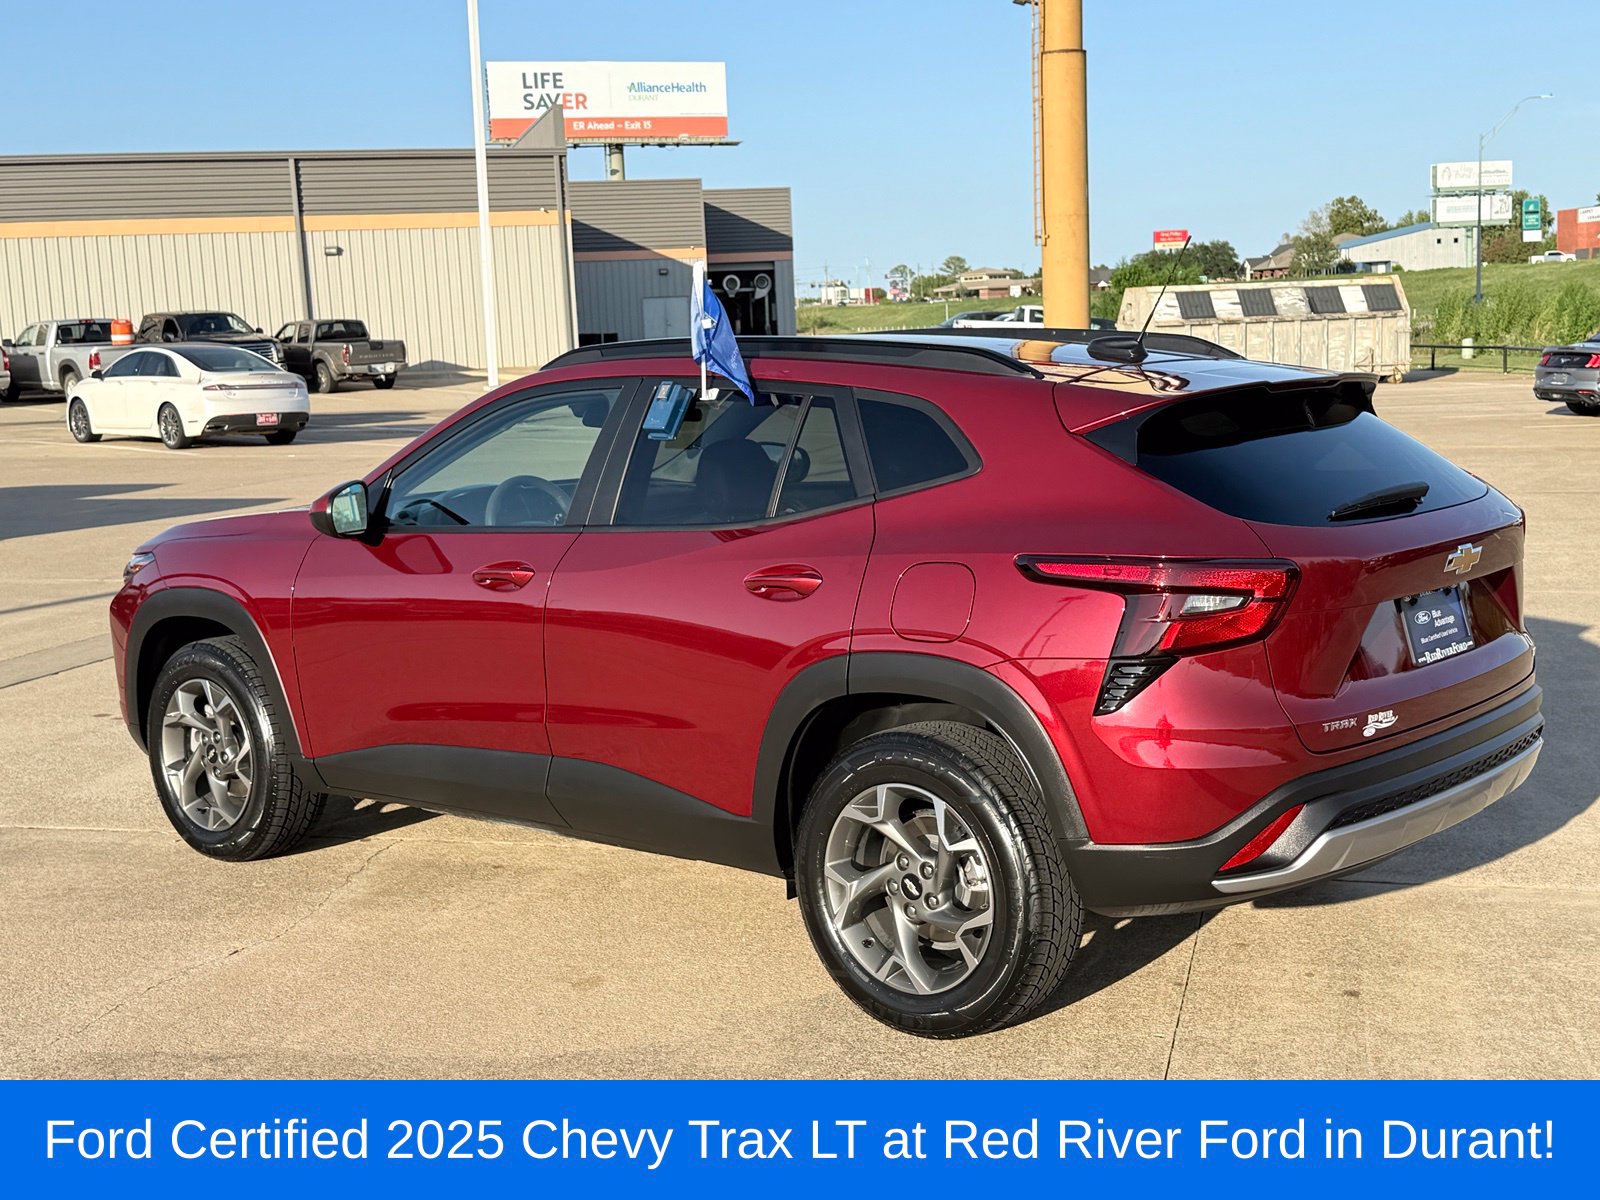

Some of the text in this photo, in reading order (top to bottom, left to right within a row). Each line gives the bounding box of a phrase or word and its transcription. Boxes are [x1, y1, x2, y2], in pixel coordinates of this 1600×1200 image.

[522, 72, 564, 89] LIFE
[627, 82, 707, 93] AllianceHealth
[523, 92, 588, 110] SAVER
[572, 121, 585, 130] ER
[587, 121, 615, 130] Ahead
[624, 120, 641, 130] Exit
[643, 120, 652, 129] 15
[1431, 609, 1442, 618] Blue
[1434, 615, 1455, 627] Advantage
[1322, 717, 1357, 732] TRAX
